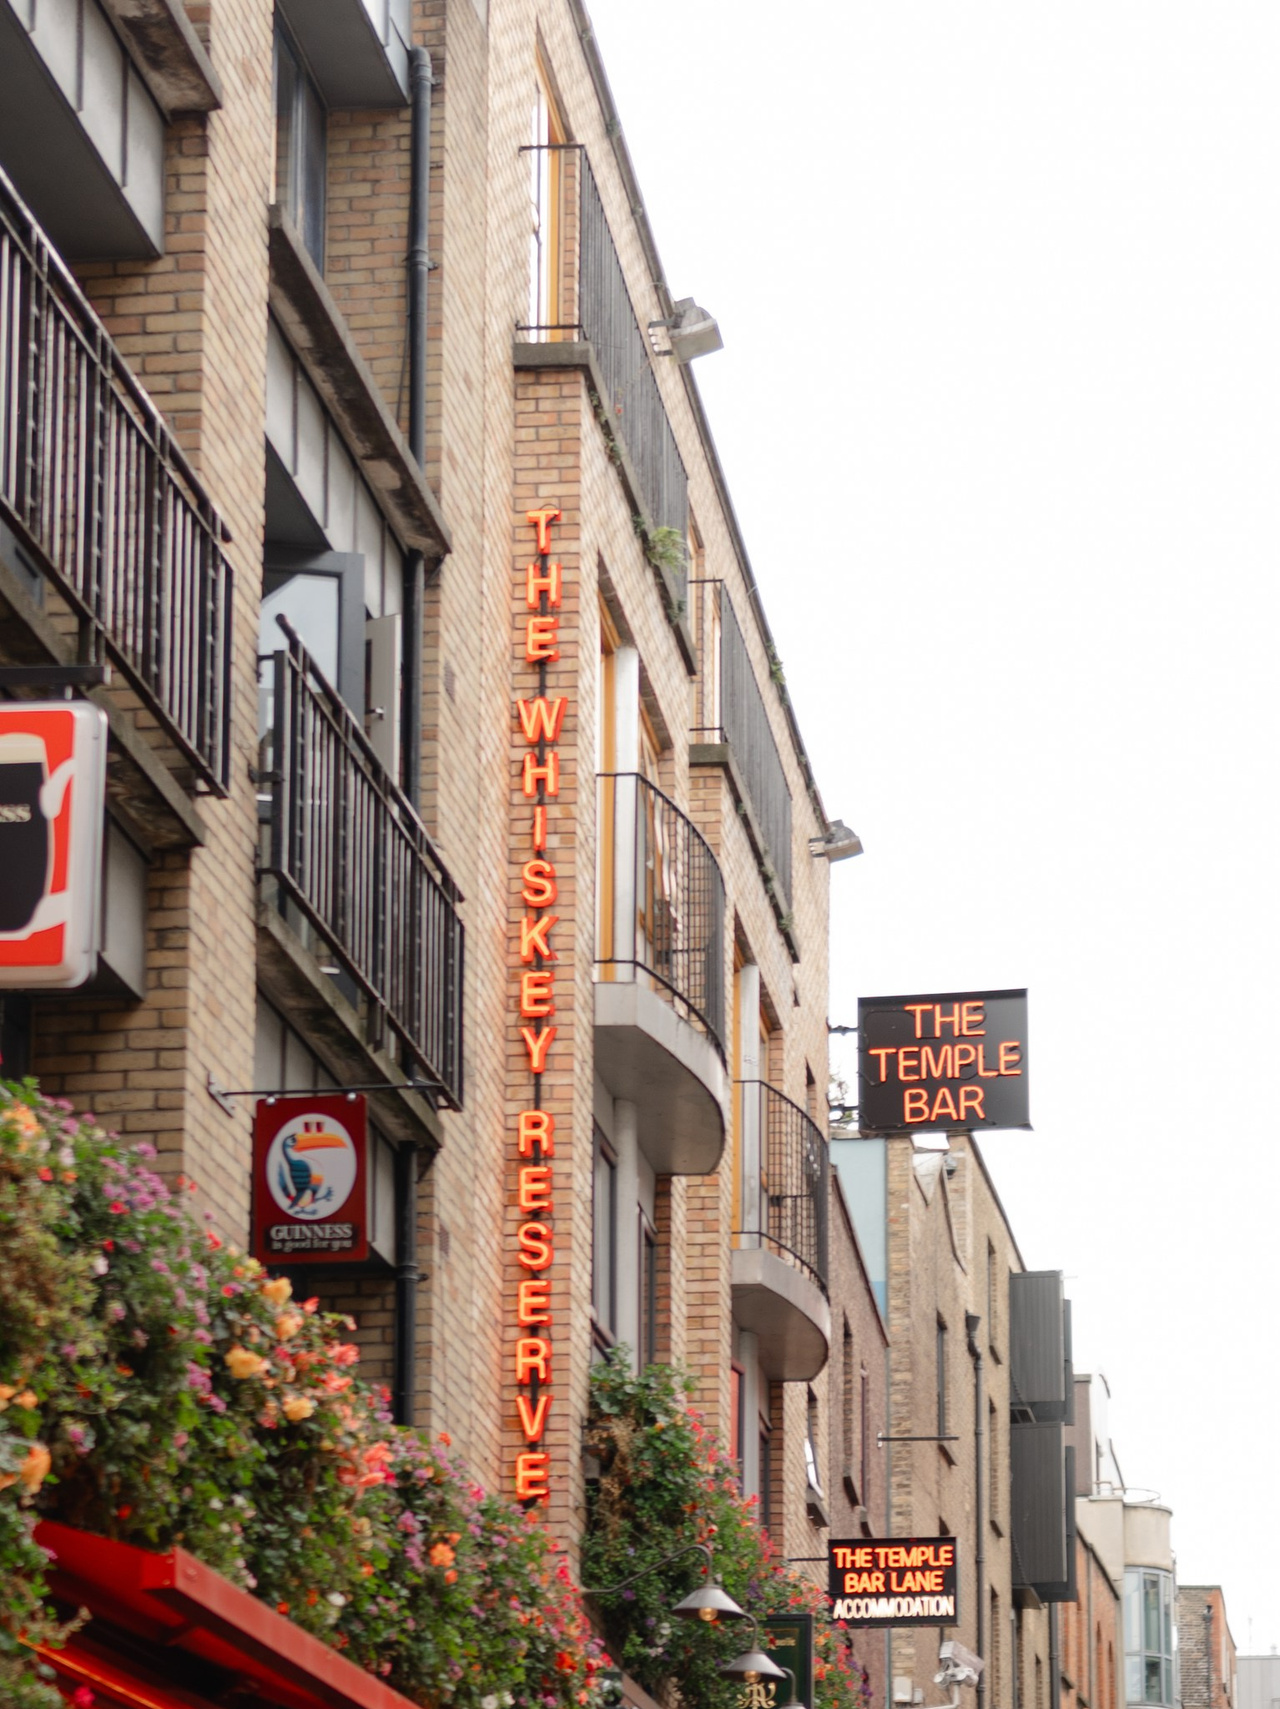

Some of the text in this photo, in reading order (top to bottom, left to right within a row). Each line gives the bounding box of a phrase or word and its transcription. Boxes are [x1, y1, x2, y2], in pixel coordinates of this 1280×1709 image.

[515, 509, 568, 1501] THE WHISKEY RESERVE
[903, 1001, 987, 1039] THE
[867, 1041, 1023, 1083] TEMPLE
[903, 1085, 986, 1124] BAR
[270, 1223, 353, 1241] GUINNESS
[832, 1545, 954, 1569] THE TEMPLE
[844, 1570, 945, 1594] BAR LANE
[832, 1595, 955, 1619] ACCOMMODATION
